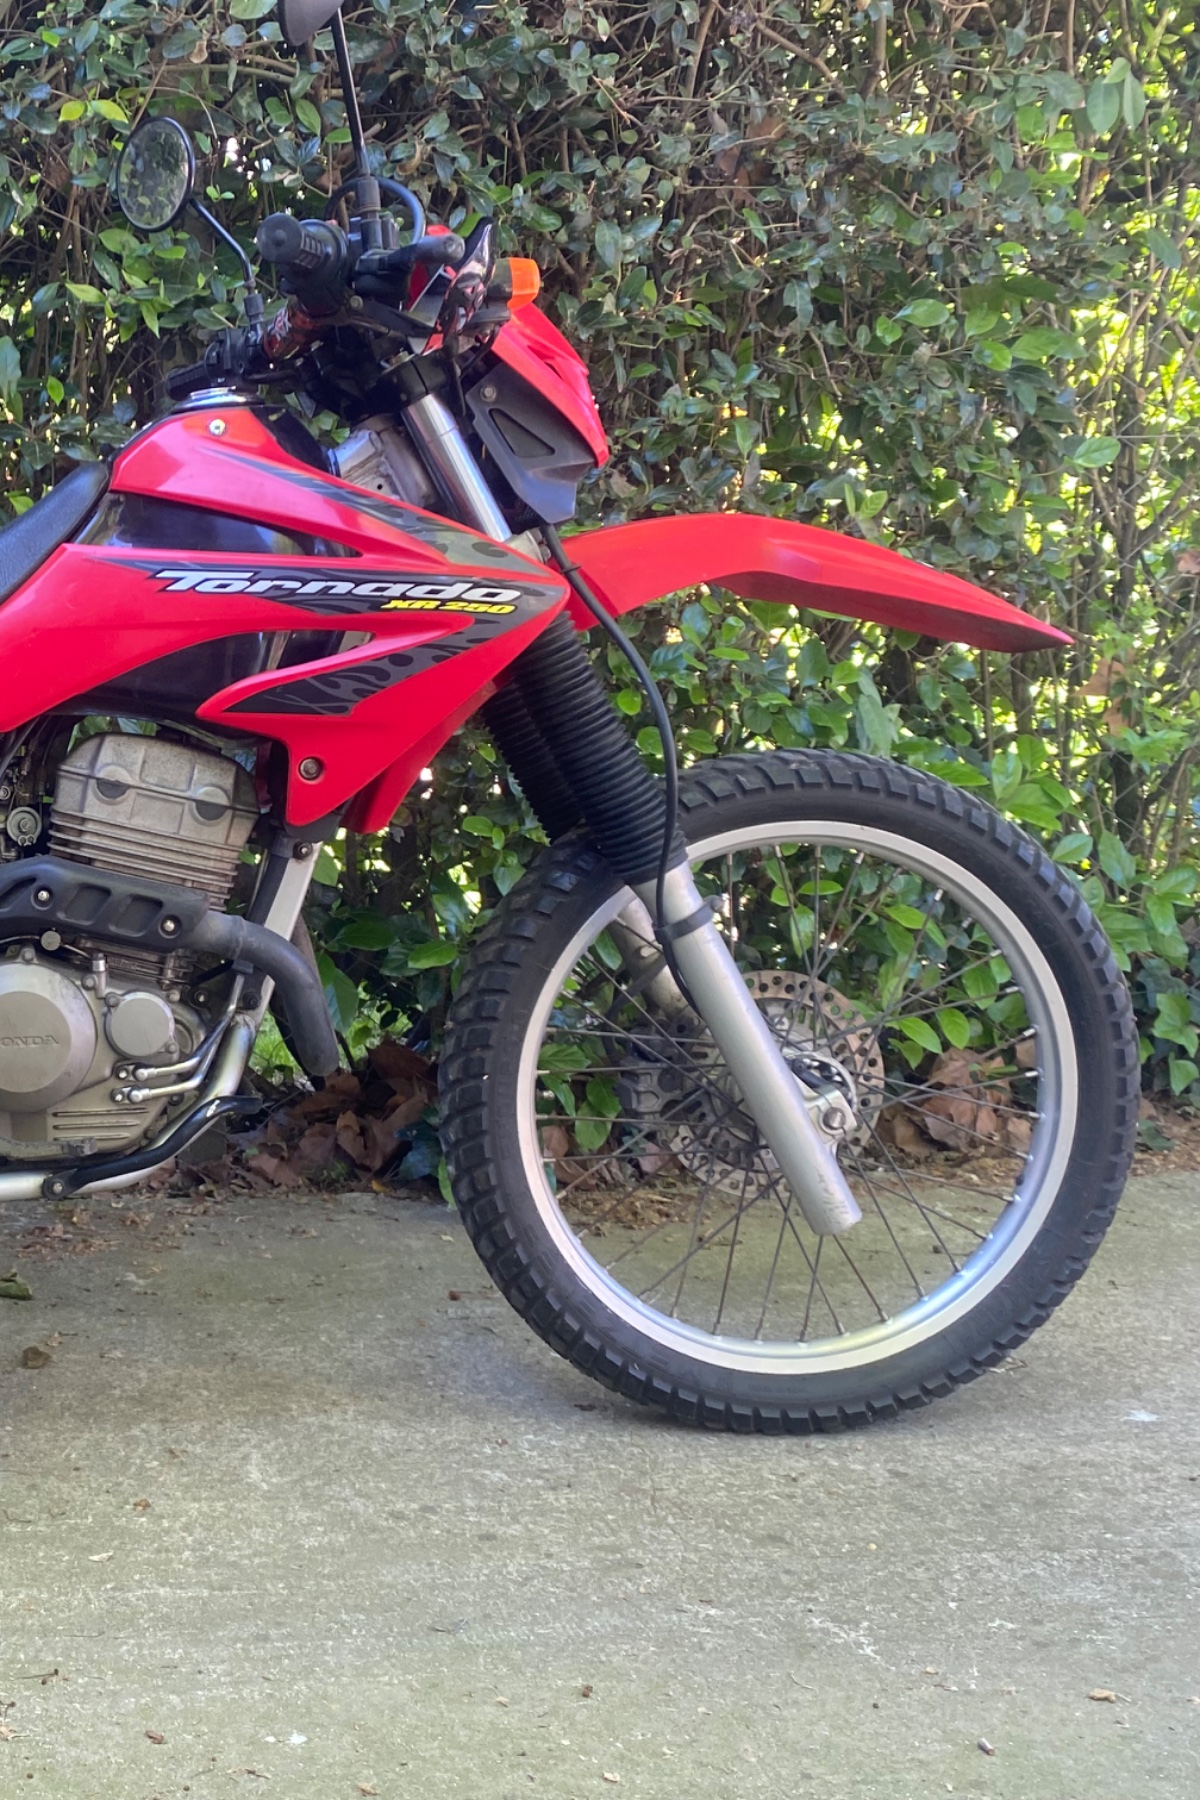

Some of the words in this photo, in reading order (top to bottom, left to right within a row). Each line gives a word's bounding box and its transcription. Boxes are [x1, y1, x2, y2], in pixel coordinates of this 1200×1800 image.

[156, 570, 521, 602] Tornado
[380, 600, 441, 609] XR
[439, 601, 516, 614] 250
